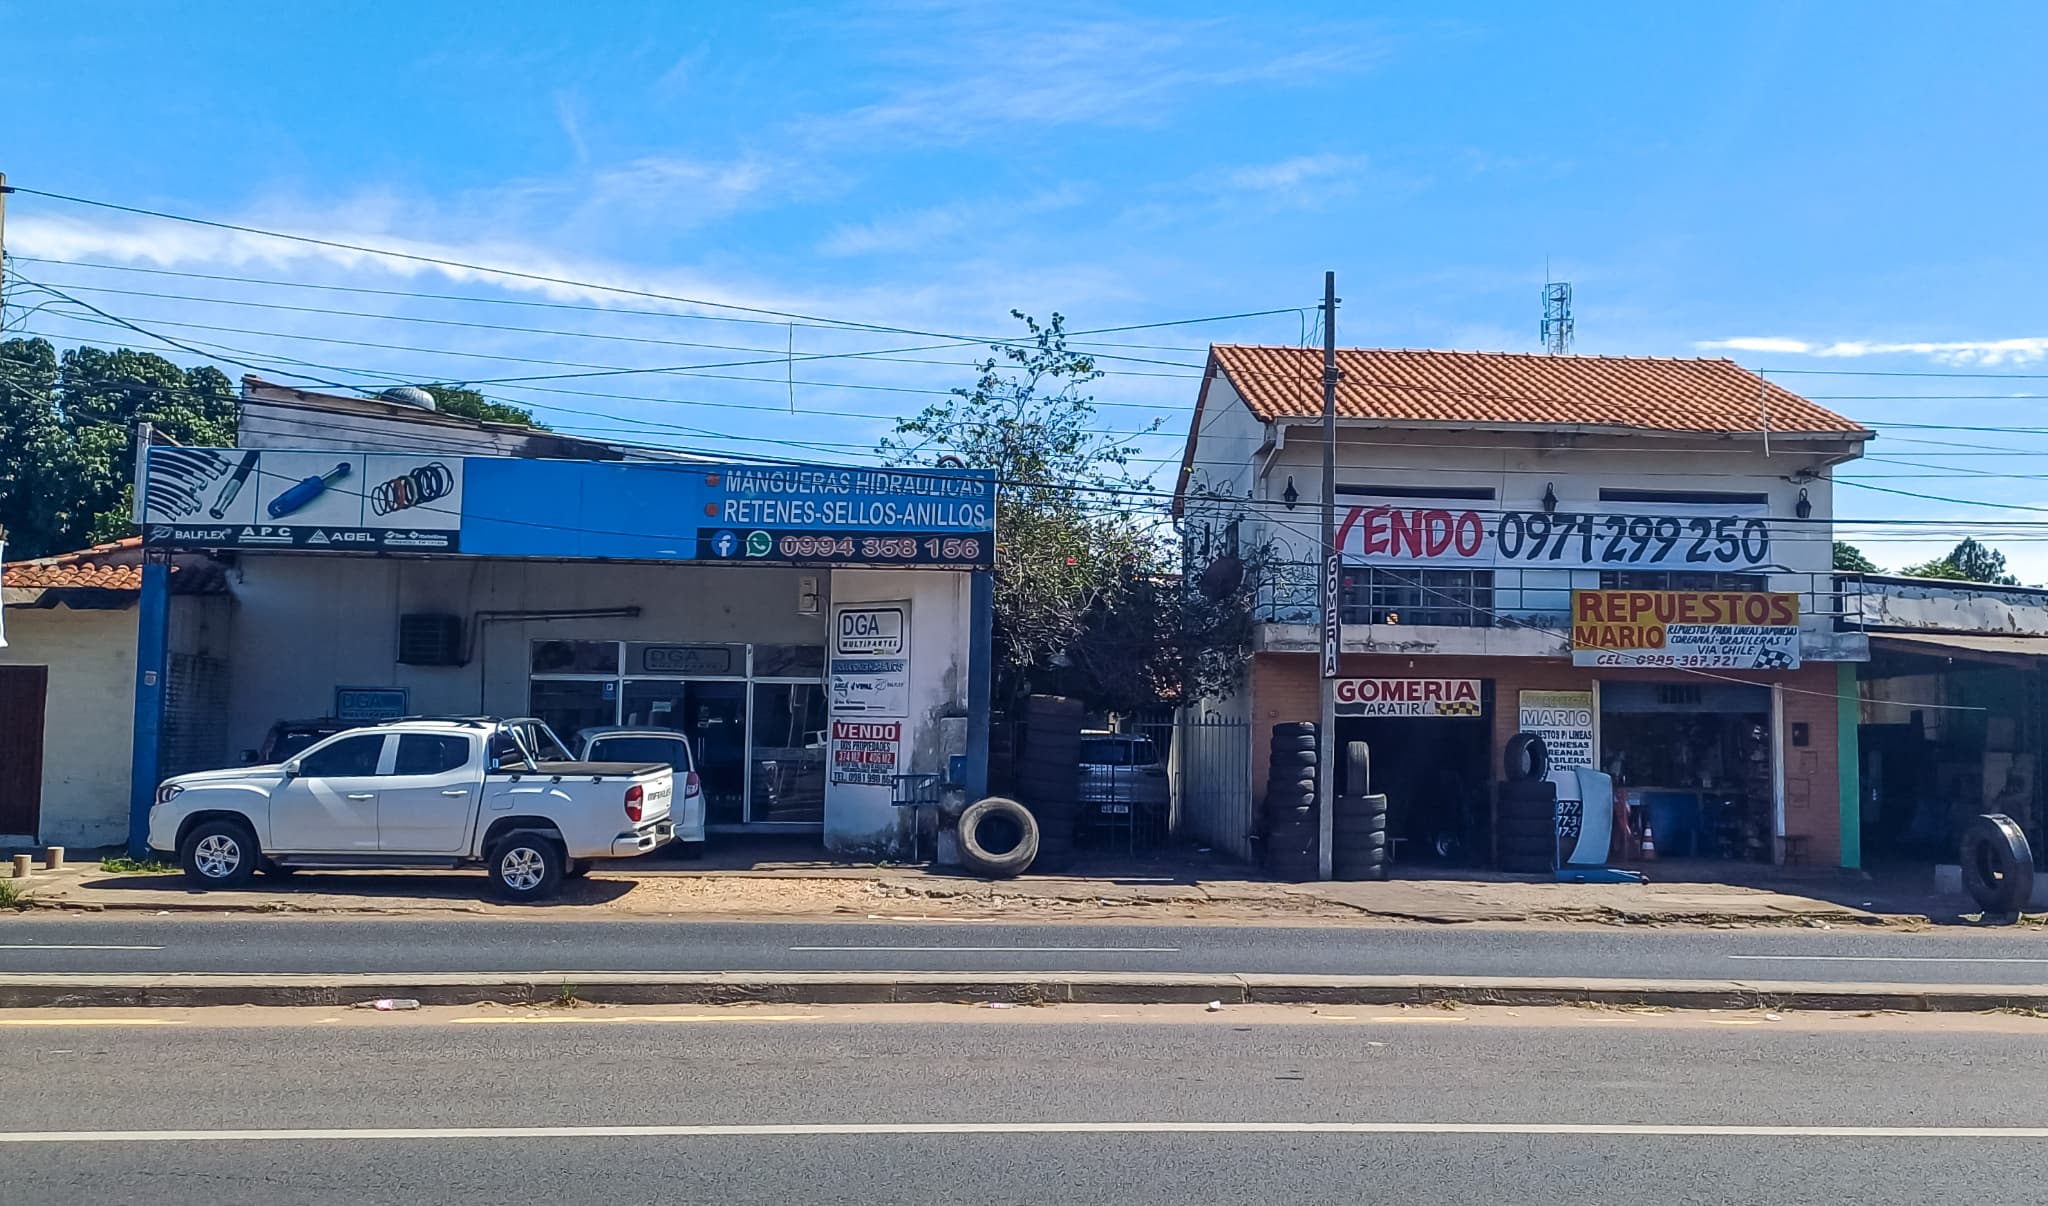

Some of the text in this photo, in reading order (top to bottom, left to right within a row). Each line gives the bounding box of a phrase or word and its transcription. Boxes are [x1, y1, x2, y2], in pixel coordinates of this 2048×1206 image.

[726, 470, 985, 497] MANGUERAS HIDRAULICAS
[724, 499, 985, 527] RETENES-SELLOS-ANILLOS
[175, 530, 226, 540] BALFLEX
[780, 535, 980, 559] 0994 358 156
[1326, 557, 1337, 672] GOMERIA
[1579, 592, 1793, 625] REPUESTOS
[843, 615, 879, 636] DGA
[1667, 625, 1710, 634] REPUESTOS
[1711, 626, 1732, 635] PARA
[1734, 627, 1758, 636] LINEAS
[1575, 625, 1665, 649] MARIO
[1783, 637, 1792, 645] Y
[1697, 645, 1717, 654] VIA
[1337, 680, 1477, 702] GOMERIA
[1521, 709, 1592, 727] MARIO
[837, 724, 896, 740] VENDO
[1569, 730, 1592, 740] LINEAS
[1547, 741, 1589, 749] PONESAS
[1553, 764, 1581, 772] CHIL
